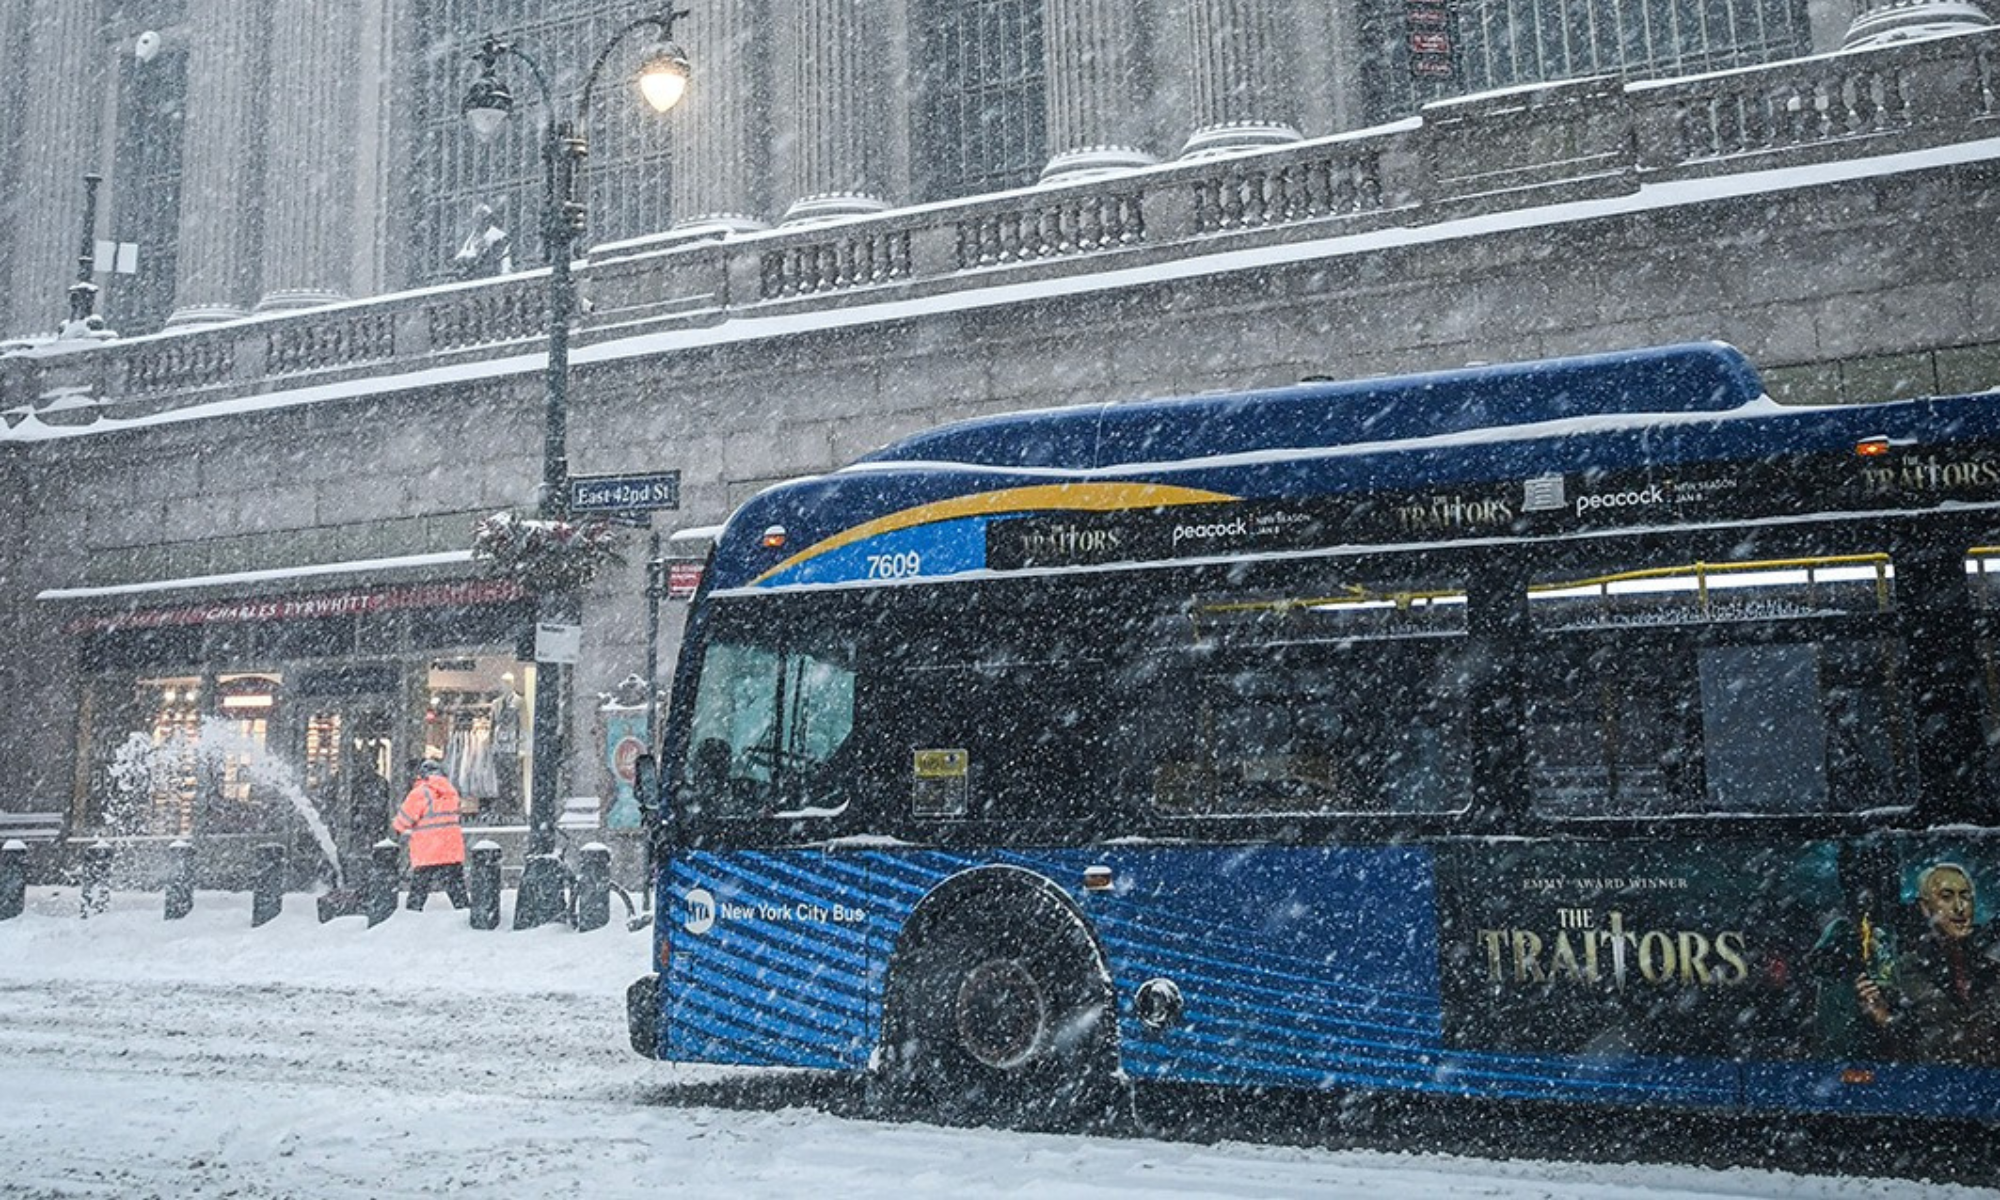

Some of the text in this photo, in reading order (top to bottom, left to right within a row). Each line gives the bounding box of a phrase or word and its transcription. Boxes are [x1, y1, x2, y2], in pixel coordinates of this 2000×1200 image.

[1861, 455, 1998, 491] TRAITORS
[579, 483, 669, 504] East 42nd St
[1577, 485, 1663, 517] peacock
[1398, 496, 1512, 527] TRAITORS
[1173, 517, 1247, 546] peacock
[867, 551, 920, 578] 7609
[206, 595, 370, 621] CHARLES TYRWHITT
[1522, 876, 1688, 889] EMMY AWARD WINNER
[685, 900, 711, 925] MTA
[720, 902, 865, 923] New York City Bus
[1557, 908, 1595, 929] THE
[1477, 911, 1749, 994] TRAITORS
